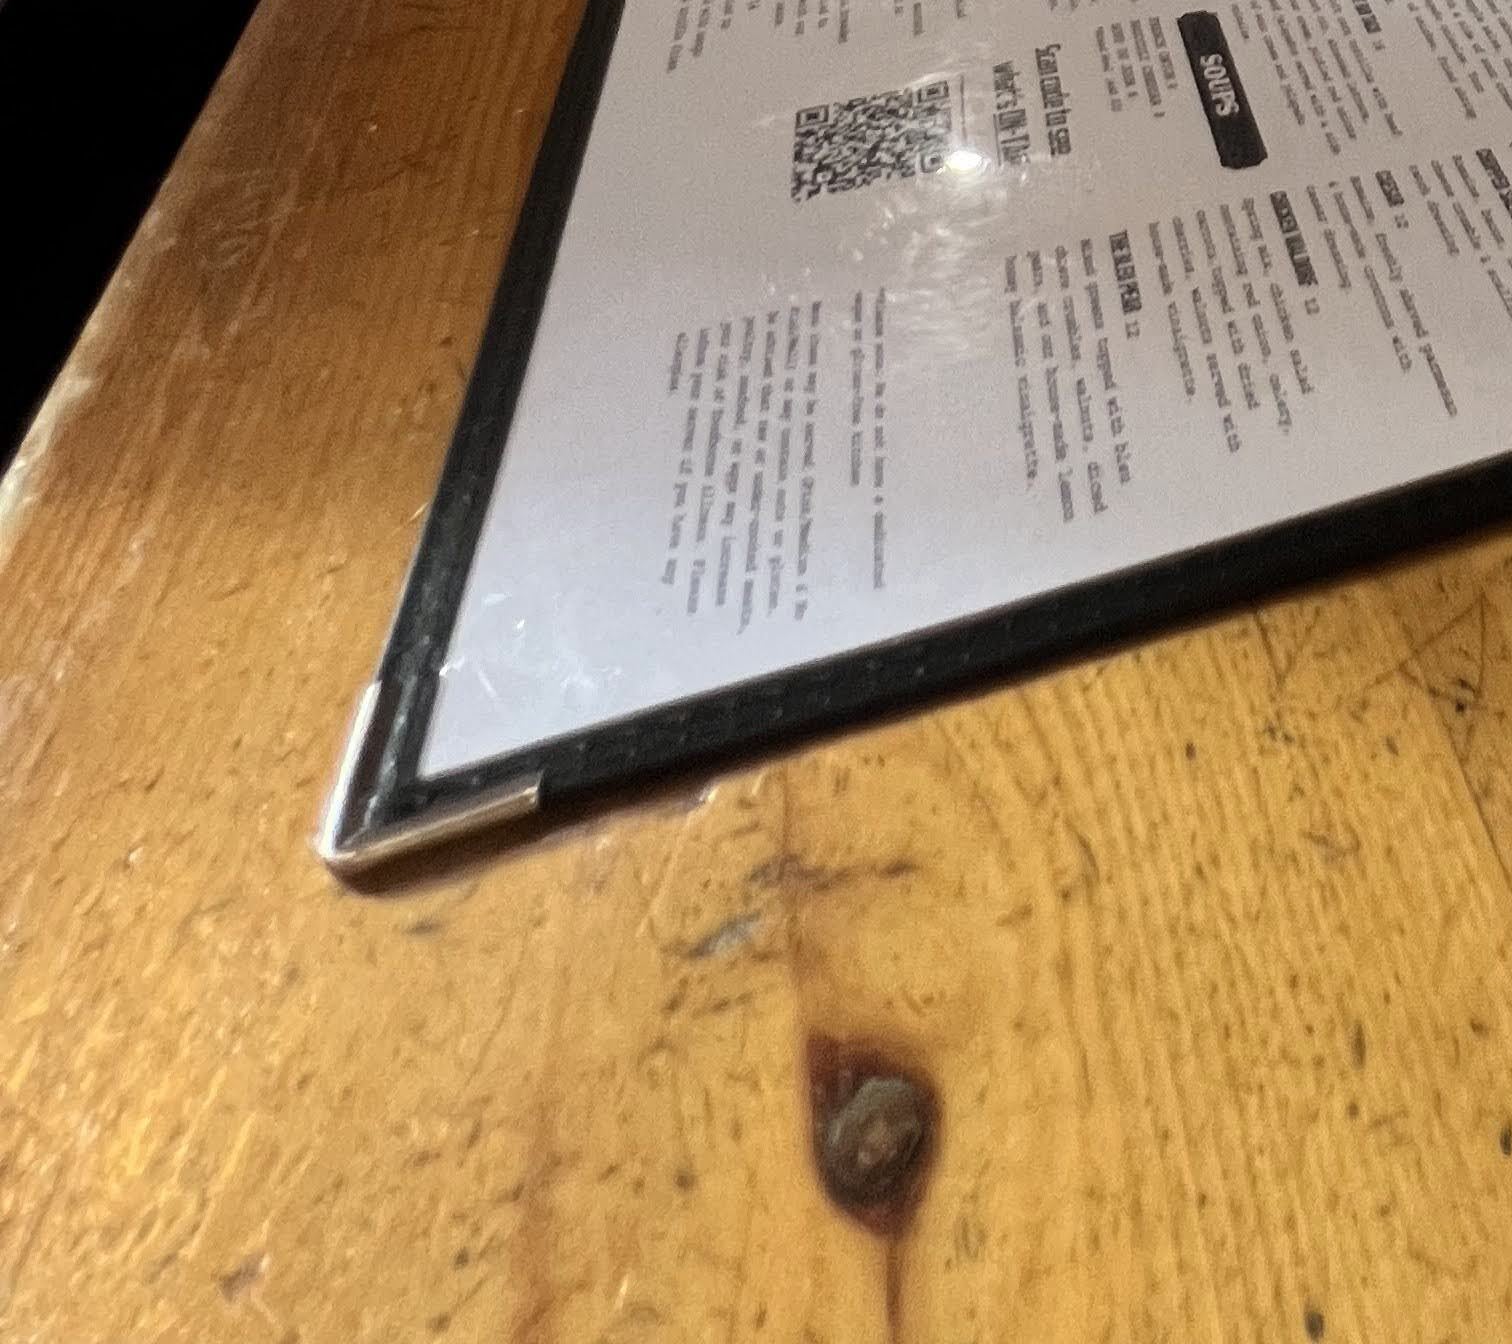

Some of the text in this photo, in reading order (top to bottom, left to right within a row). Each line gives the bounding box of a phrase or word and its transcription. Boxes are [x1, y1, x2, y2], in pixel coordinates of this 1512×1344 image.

[1034, 43, 1061, 76] Scan
[992, 60, 1021, 110] what's
[1039, 75, 1069, 109] code
[1200, 54, 1239, 115] SOUPS
[1047, 127, 1071, 156] see
[1108, 229, 1130, 255] THE
[1118, 281, 1142, 314] PEAR
[1086, 461, 1107, 514] diced
